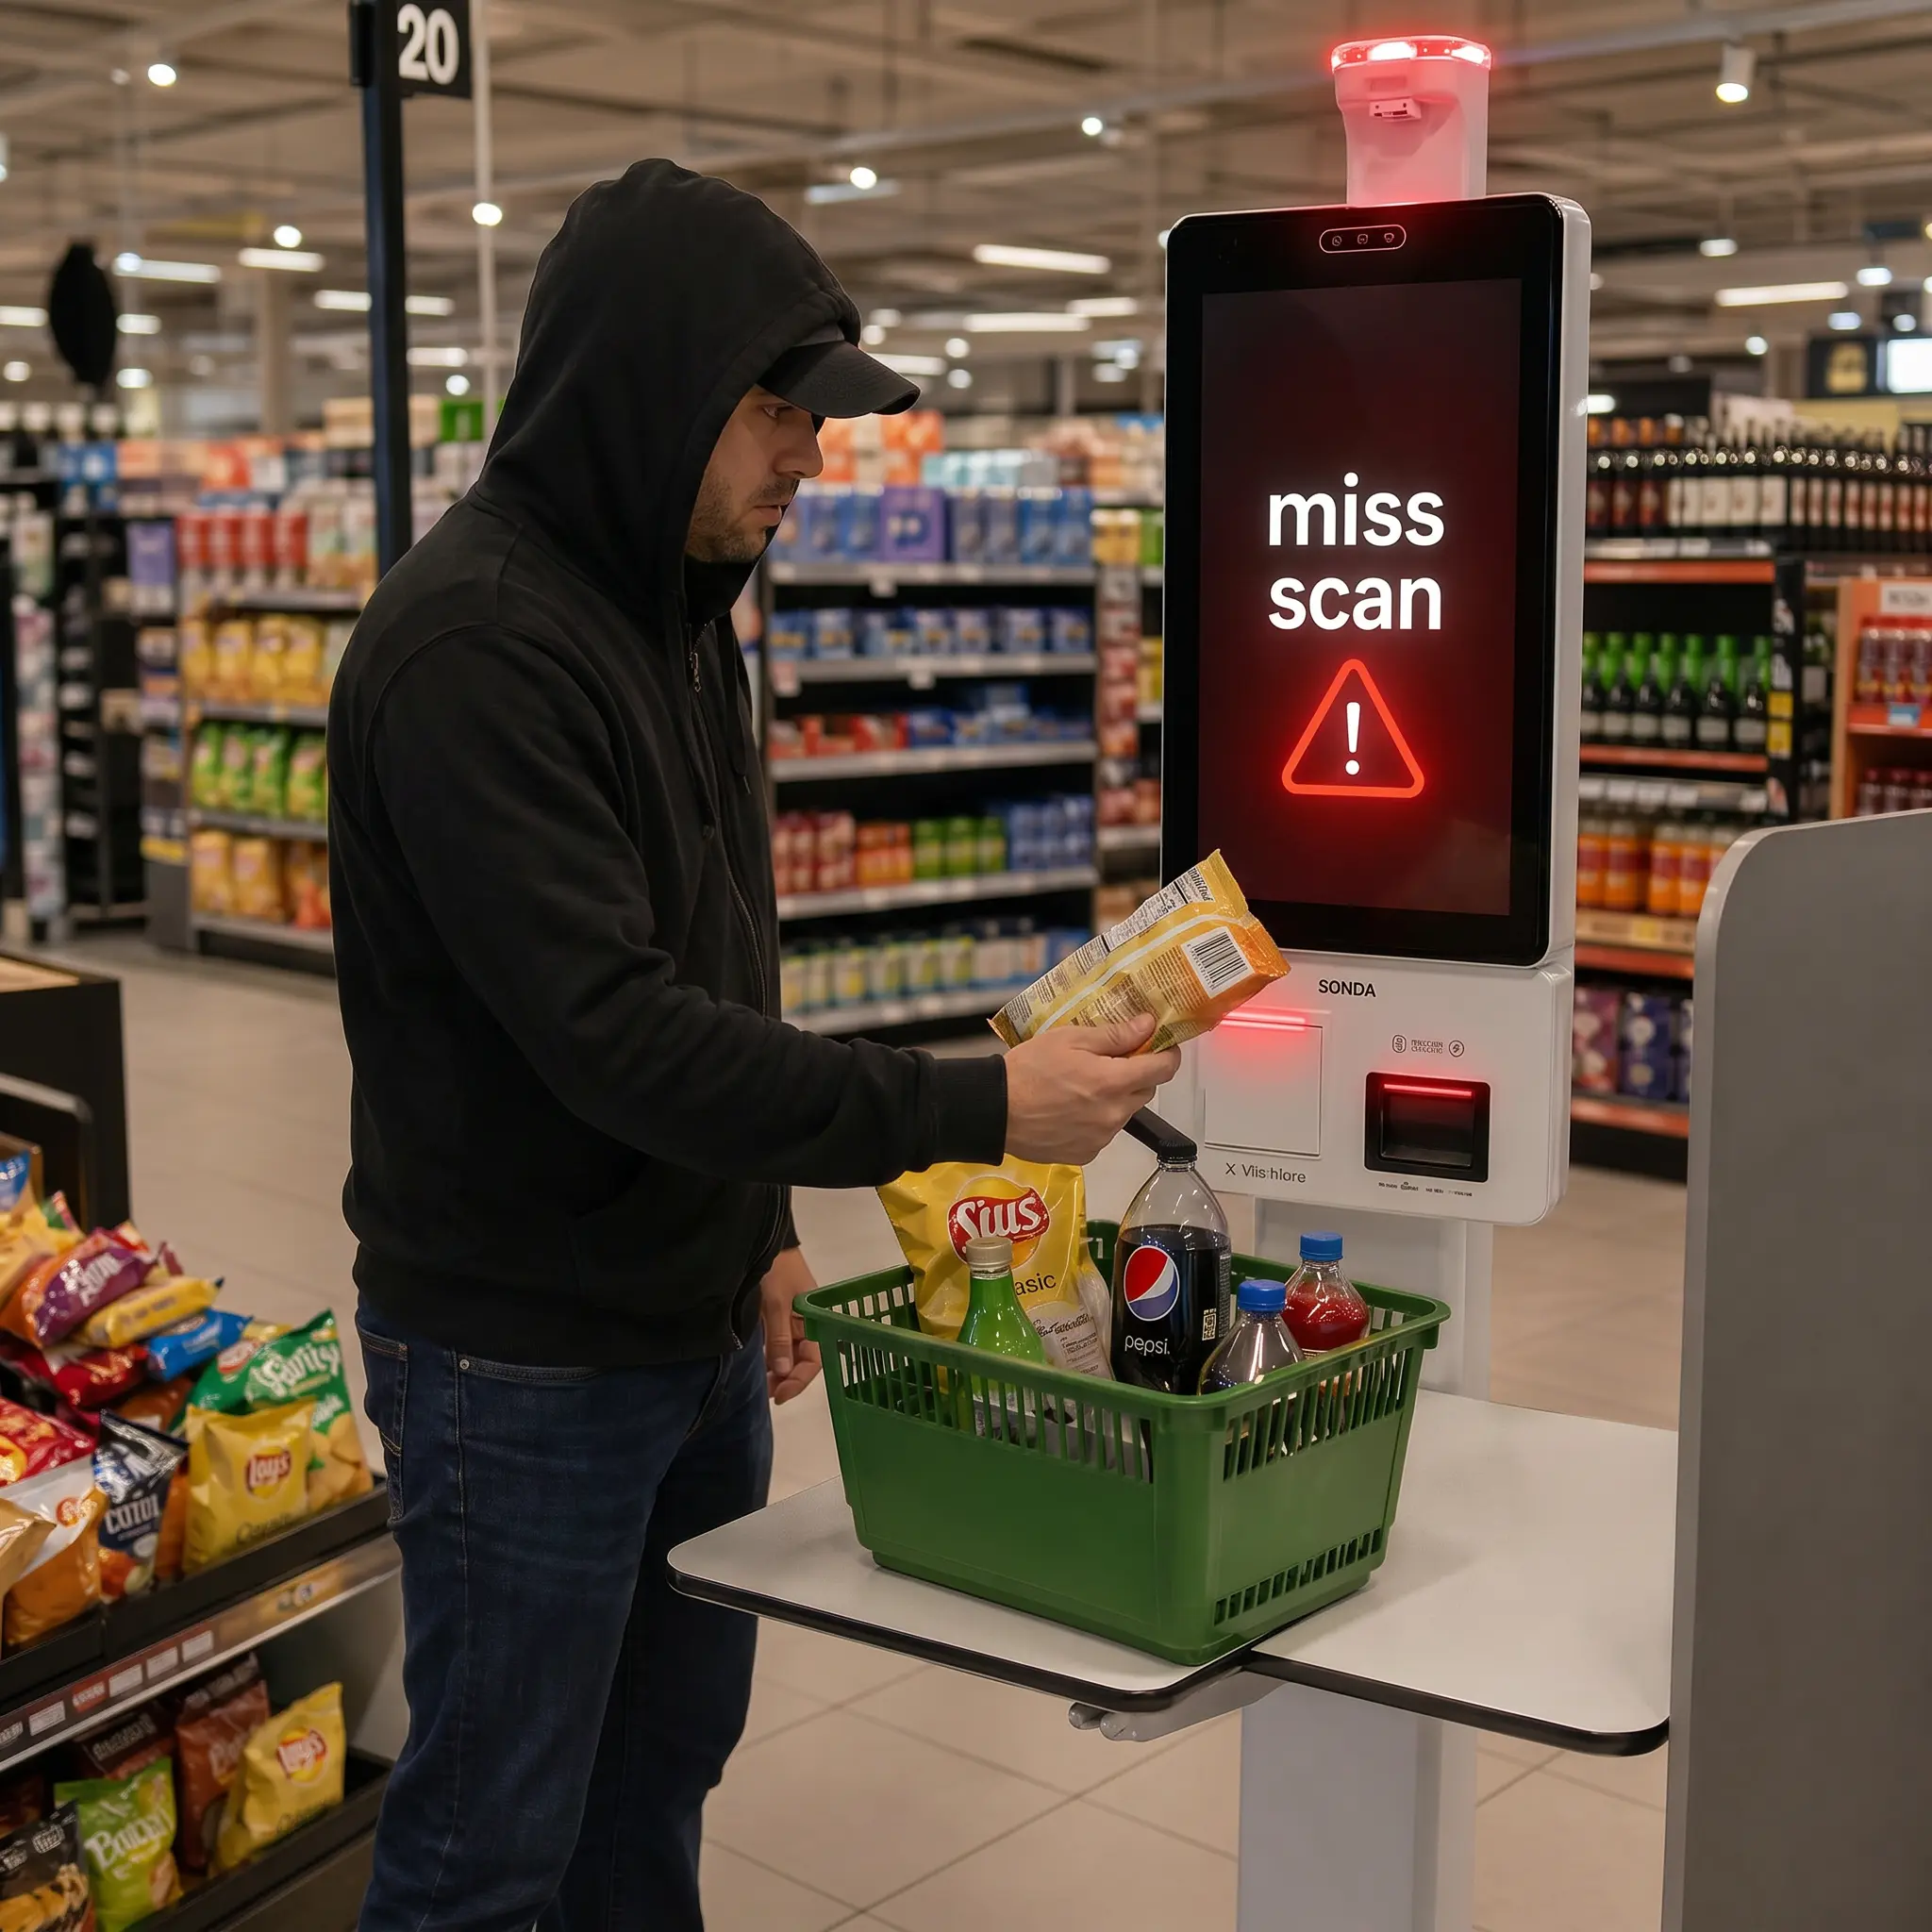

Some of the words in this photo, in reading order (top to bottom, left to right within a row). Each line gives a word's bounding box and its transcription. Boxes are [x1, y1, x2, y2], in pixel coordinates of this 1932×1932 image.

[397, 3, 459, 85] 20
[1268, 472, 1444, 546] miss
[1268, 576, 1441, 630] scan
[1318, 979, 1376, 997] SONDA
[1015, 1273, 1057, 1296] asic
